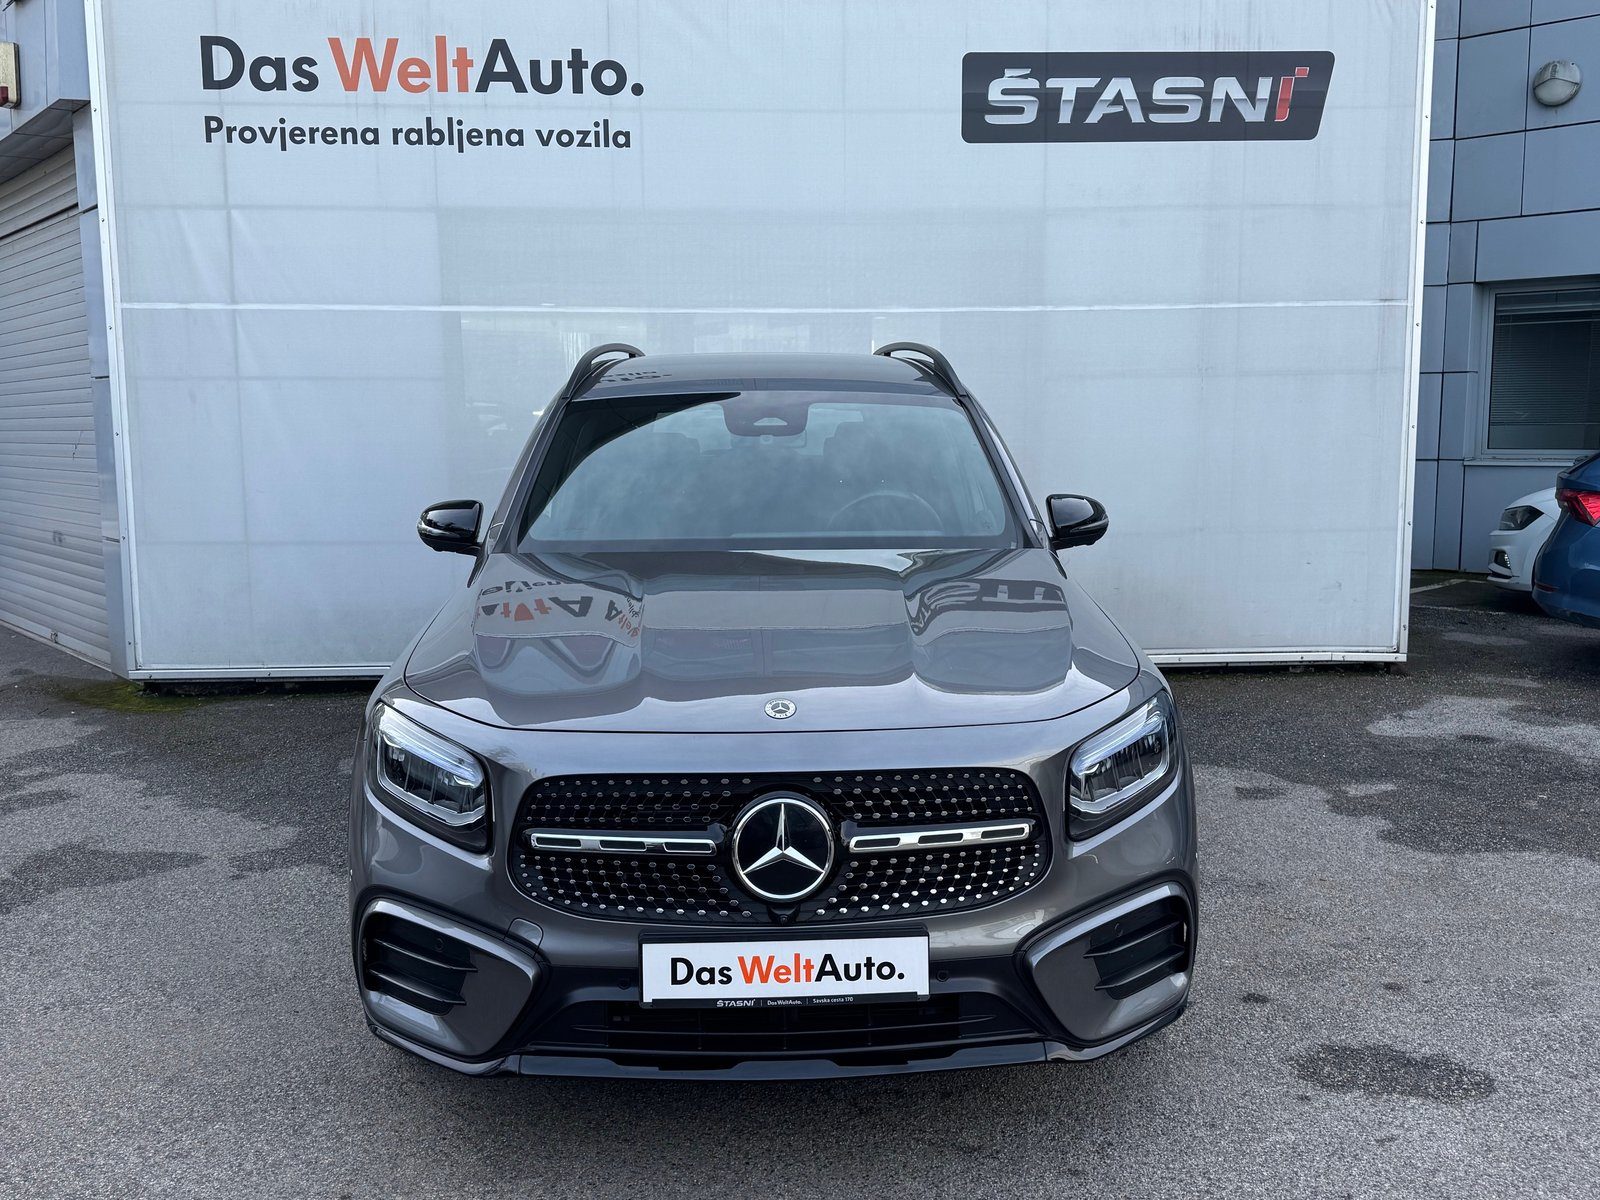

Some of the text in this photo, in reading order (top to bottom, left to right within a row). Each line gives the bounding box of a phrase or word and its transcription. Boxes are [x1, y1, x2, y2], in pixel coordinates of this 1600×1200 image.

[199, 35, 645, 96] Das WeltAuto.
[203, 115, 632, 153] Provjerena rabljena vozila
[670, 952, 906, 986] Das WeltAuto.
